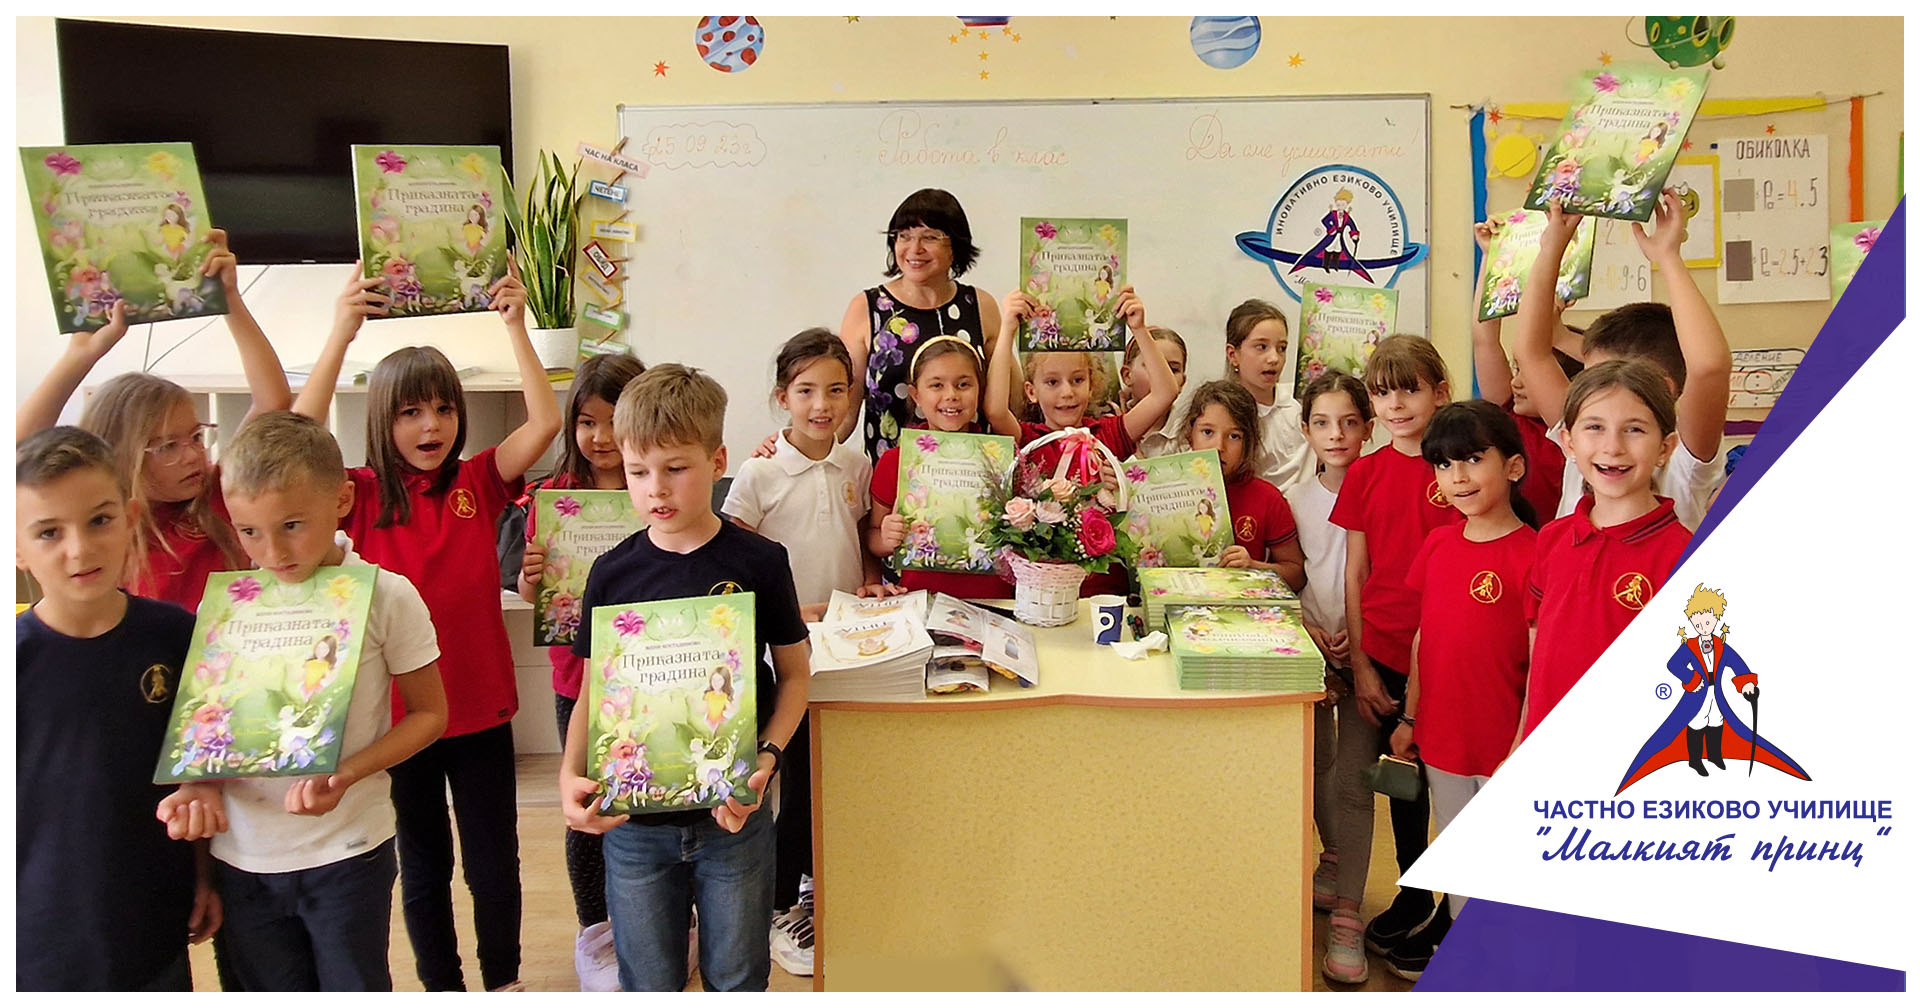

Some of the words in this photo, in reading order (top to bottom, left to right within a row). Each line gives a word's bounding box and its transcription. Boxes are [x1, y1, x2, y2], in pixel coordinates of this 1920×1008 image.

[1591, 105, 1668, 118] Приказната
[1598, 119, 1651, 129] градина
[1186, 109, 1236, 161] Да
[1015, 150, 1069, 166] клас
[1736, 138, 1811, 160] ОБИКОЛКА
[584, 147, 600, 160] ЧАС
[601, 153, 613, 163] НА
[613, 157, 639, 172] КЛАСА
[1333, 174, 1383, 199] ЕЗИКОВО
[388, 188, 478, 204] Приказната
[1276, 175, 1328, 235] ИНОВАТИВНО
[405, 205, 466, 216] градина
[1382, 199, 1399, 256] УЧИЛИЩЕ
[1041, 251, 1108, 263] Приказната
[1053, 264, 1098, 273] градина
[1327, 325, 1368, 335] градина
[1136, 487, 1206, 504] Приказната
[1150, 501, 1197, 513] градина
[228, 617, 332, 638] Приказната
[242, 634, 314, 653] градина
[622, 649, 720, 671] Приказната
[639, 667, 708, 686] градина
